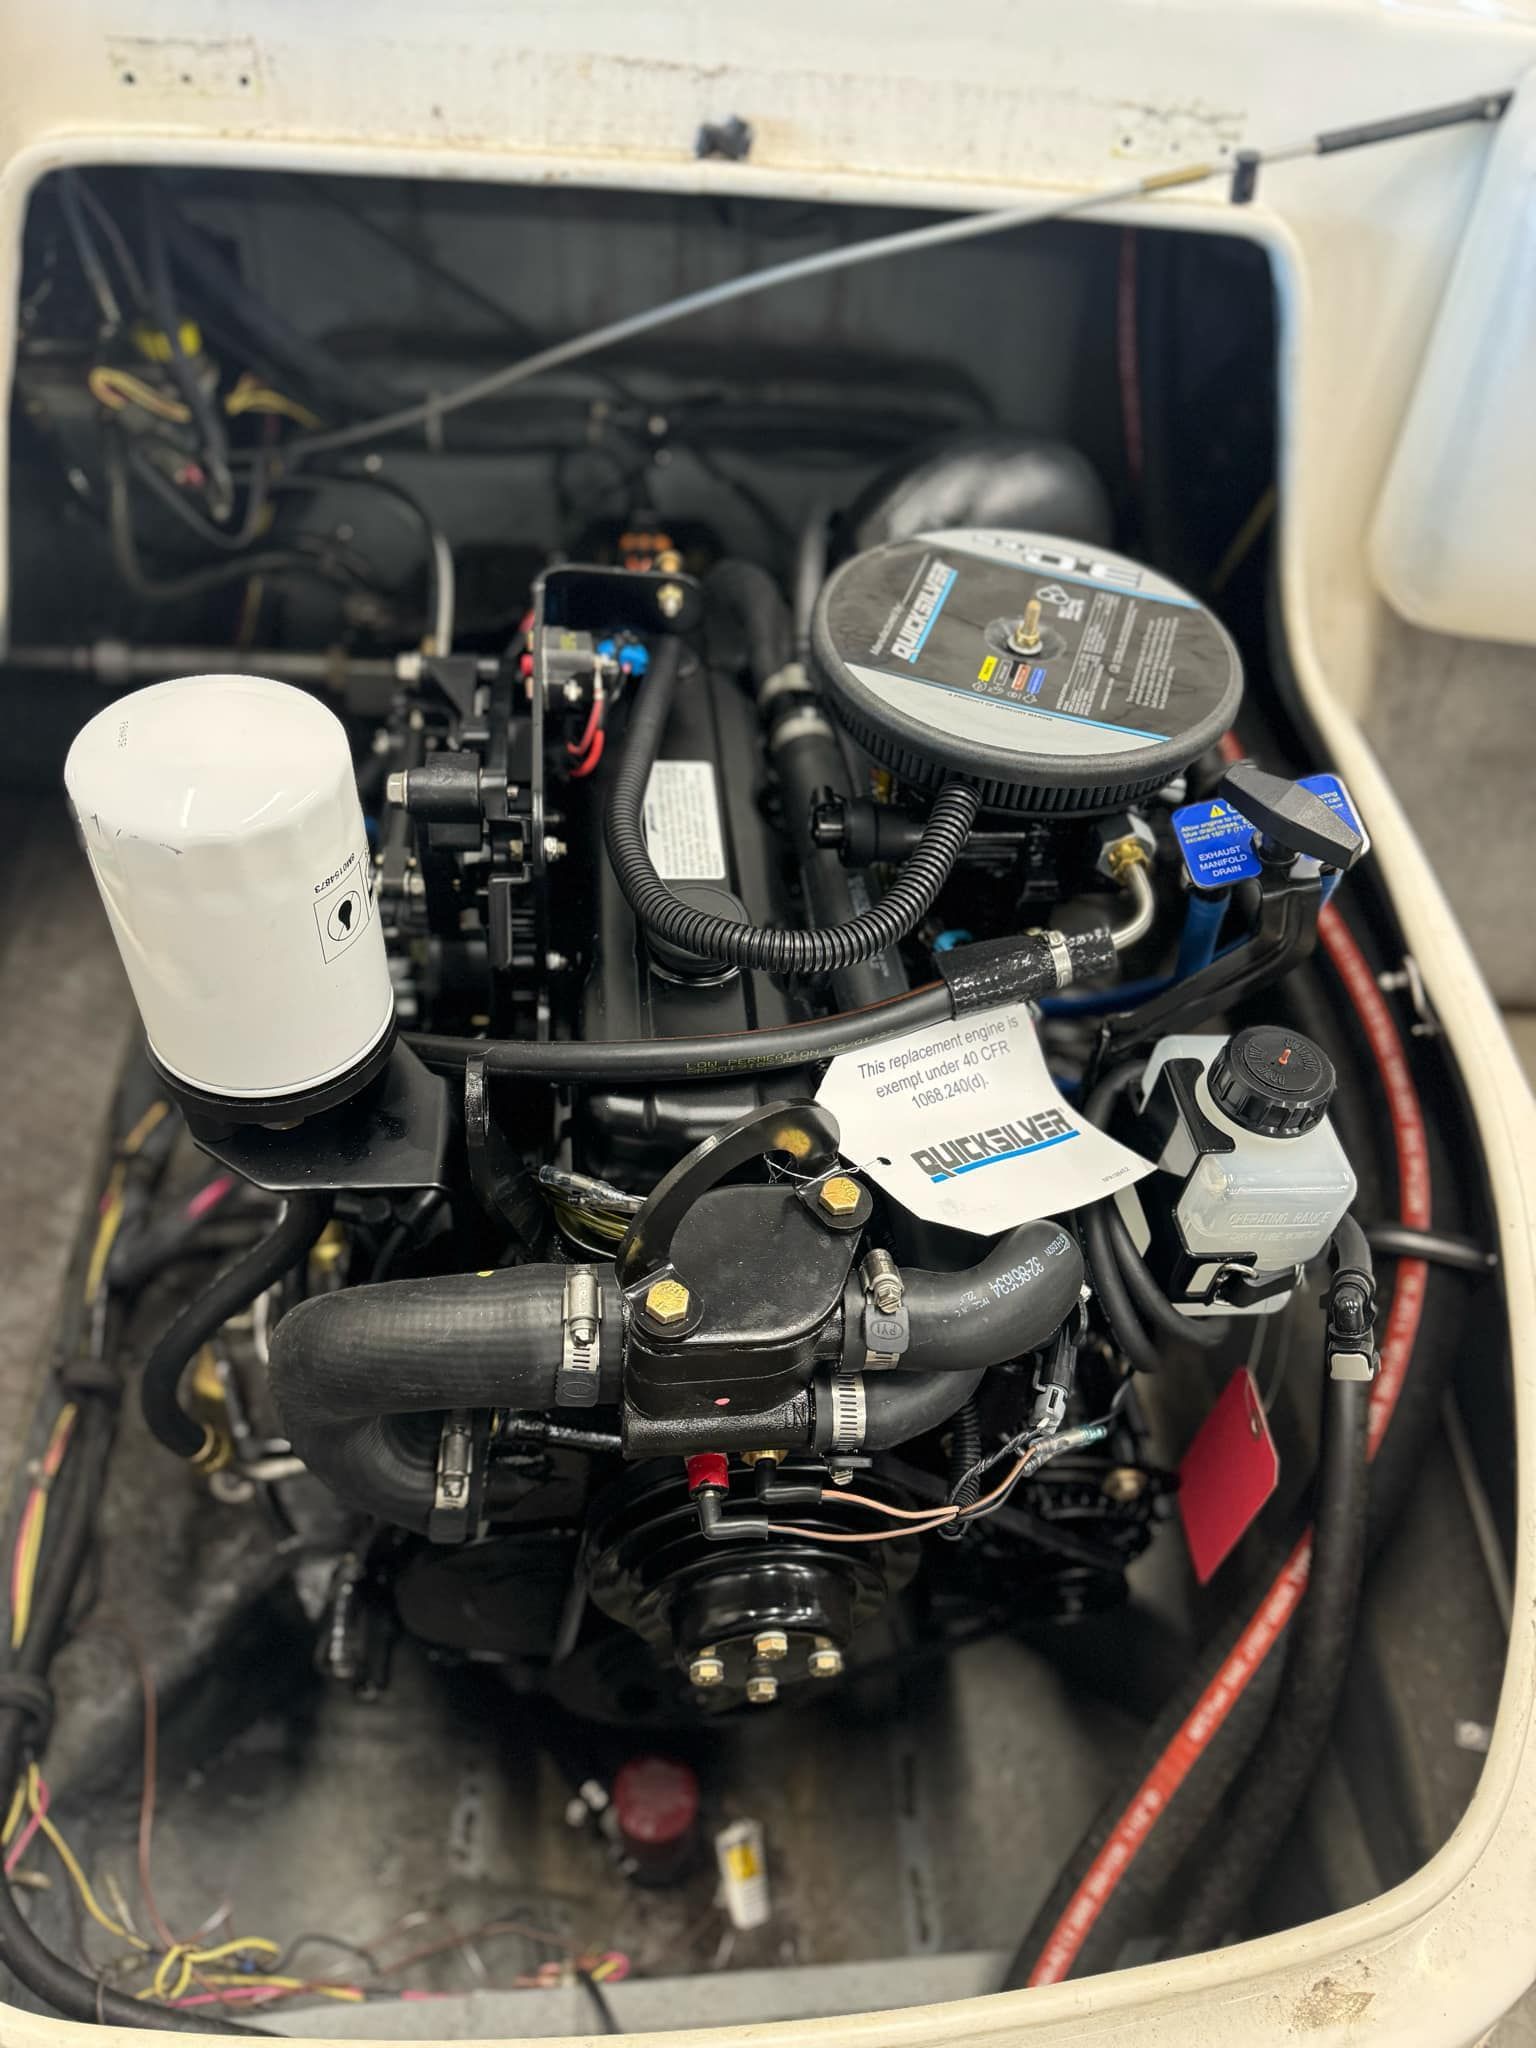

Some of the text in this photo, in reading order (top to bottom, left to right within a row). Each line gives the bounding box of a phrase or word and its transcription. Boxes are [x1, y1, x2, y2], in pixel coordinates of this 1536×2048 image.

[891, 558, 953, 661] QUICKSILVER
[1198, 844, 1241, 861] EXHAUST
[1199, 854, 1248, 871] MANIFOLD
[1212, 864, 1242, 877] DRAIN
[857, 1015, 1019, 1080] This replacement engine is
[876, 1040, 1011, 1098] exempt under 40 CFR
[911, 1072, 990, 1110] 1068.240(d).
[910, 1108, 1073, 1178] QUICKSILVER
[1229, 1211, 1333, 1225] OPERATING RANGE
